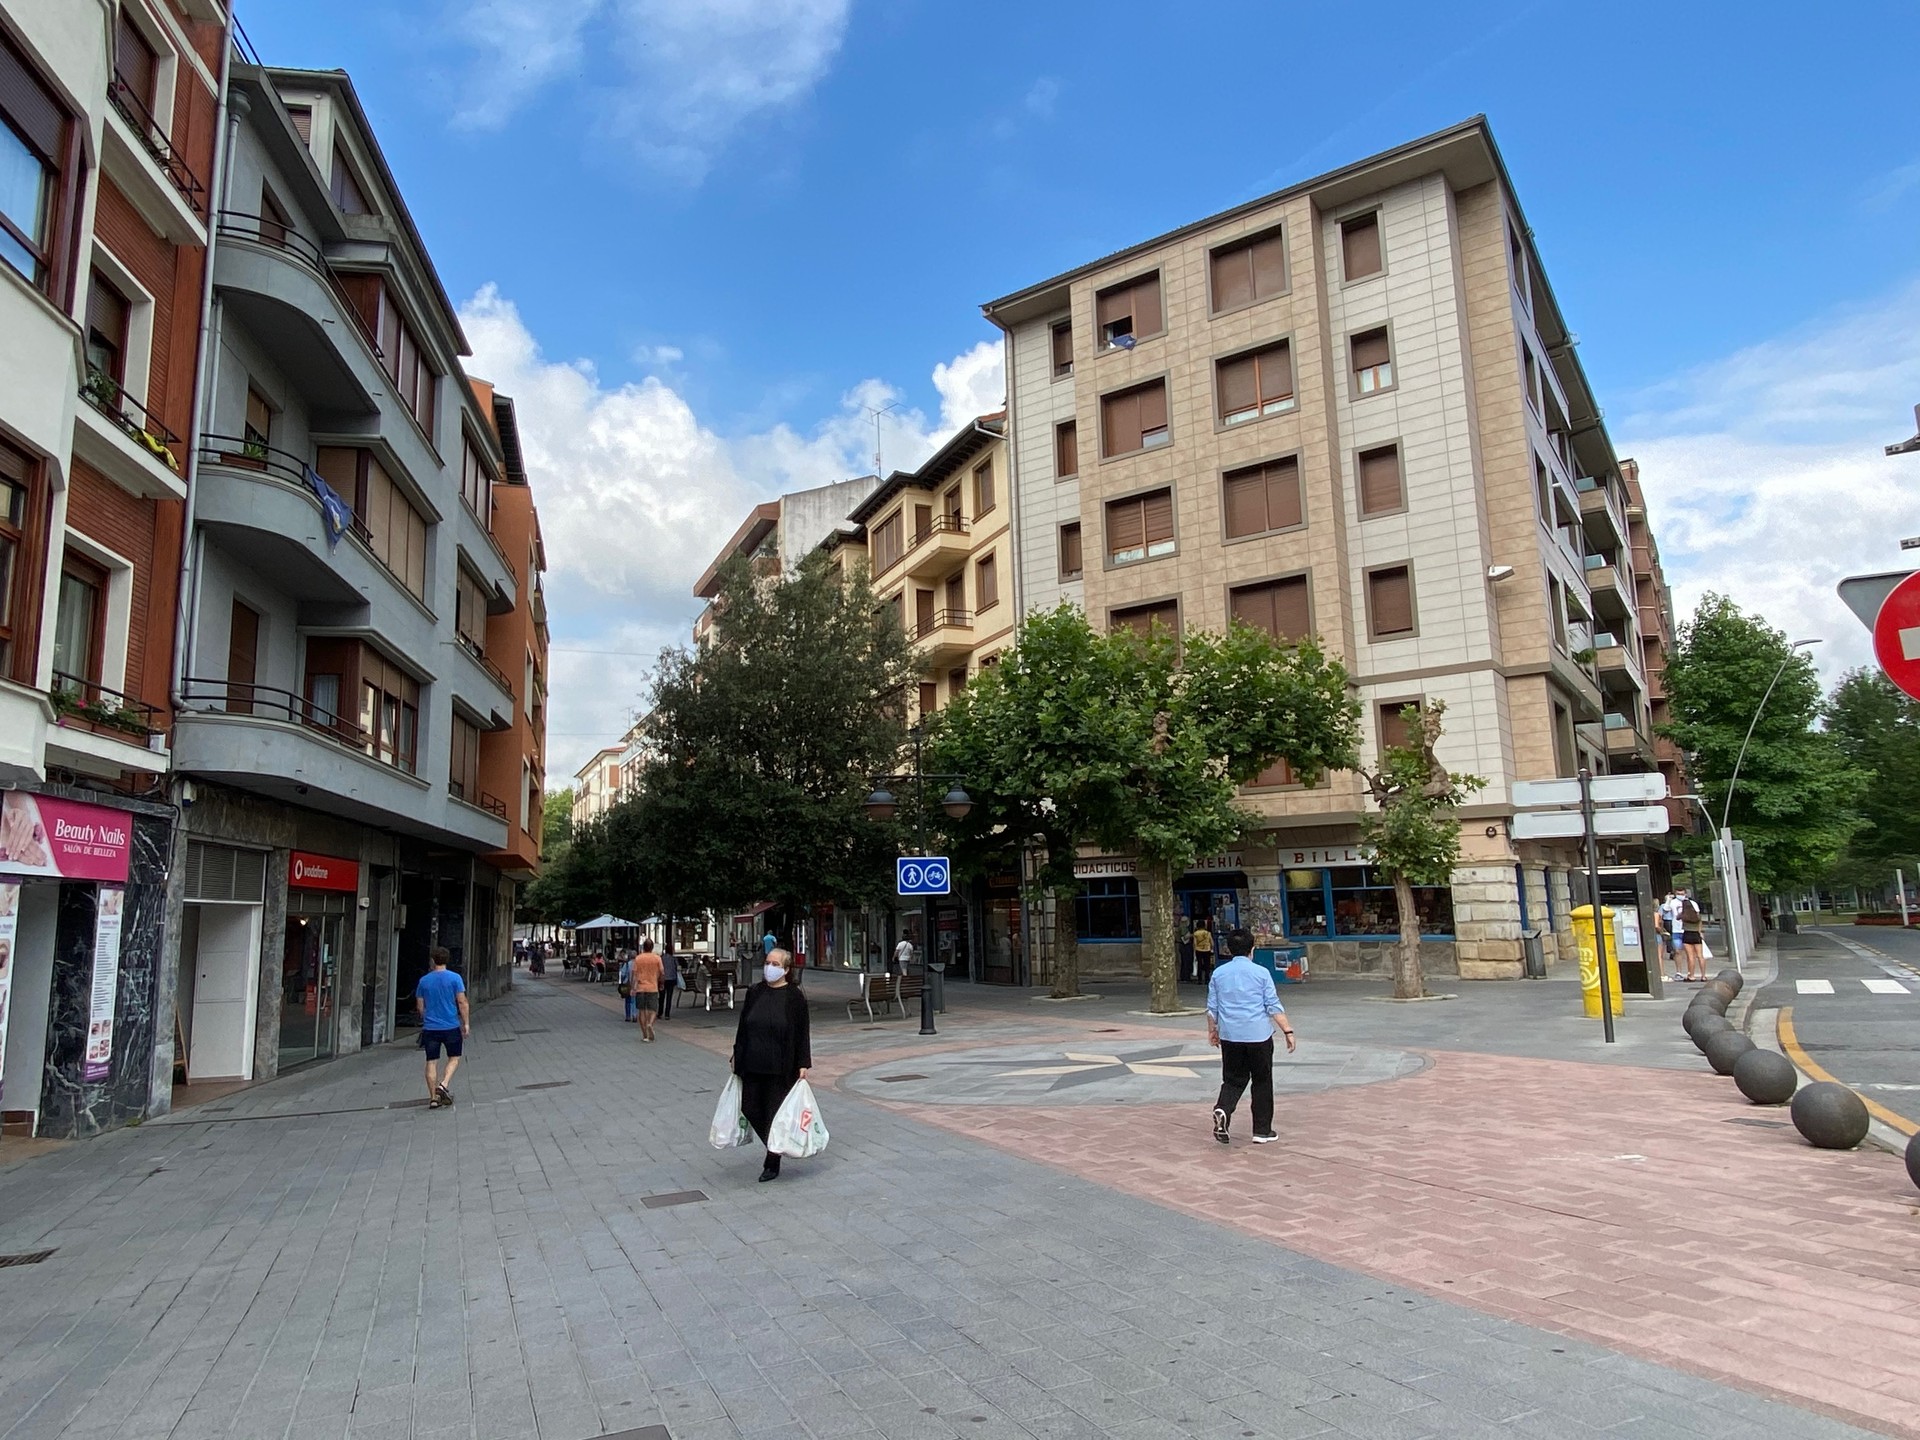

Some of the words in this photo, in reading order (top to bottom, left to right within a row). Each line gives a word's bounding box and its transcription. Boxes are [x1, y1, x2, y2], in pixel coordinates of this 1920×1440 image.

[55, 818, 97, 846] Beauty
[99, 825, 126, 846] Nails
[63, 843, 82, 854] SALÓN
[83, 846, 92, 855] DE
[93, 847, 117, 858] BELLEZA
[1293, 850, 1366, 864] BILL
[303, 865, 329, 879] vodafone
